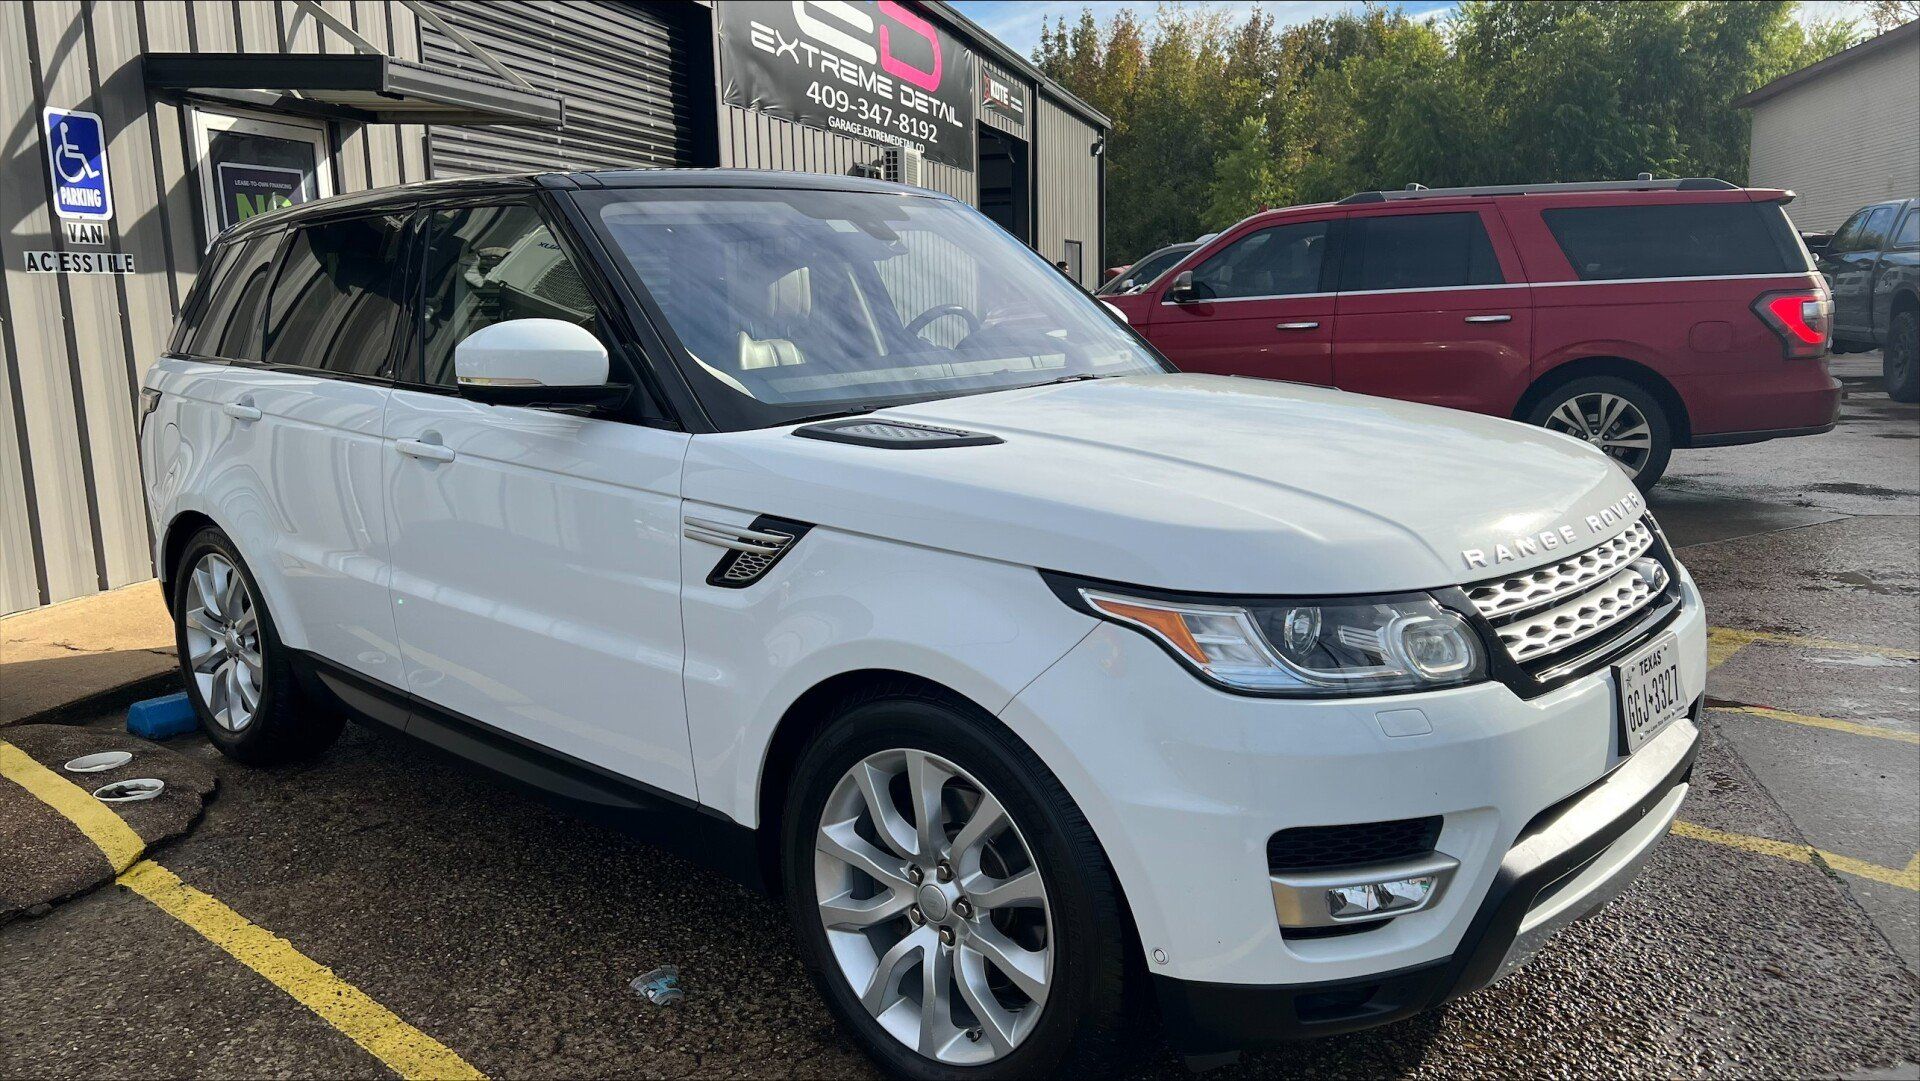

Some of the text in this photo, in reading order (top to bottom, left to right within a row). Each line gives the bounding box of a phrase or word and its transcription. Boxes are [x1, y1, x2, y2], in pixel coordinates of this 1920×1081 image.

[750, 20, 964, 128] EXTREME DETAIL
[805, 81, 938, 144] 409-347-8192
[828, 115, 925, 154] GARAGE.EXTREMEDETAILCO
[60, 186, 102, 208] PARKING
[68, 223, 103, 244] VAN
[1462, 491, 1640, 571] RANGE ROVER
[1639, 650, 1662, 676] TEXAS
